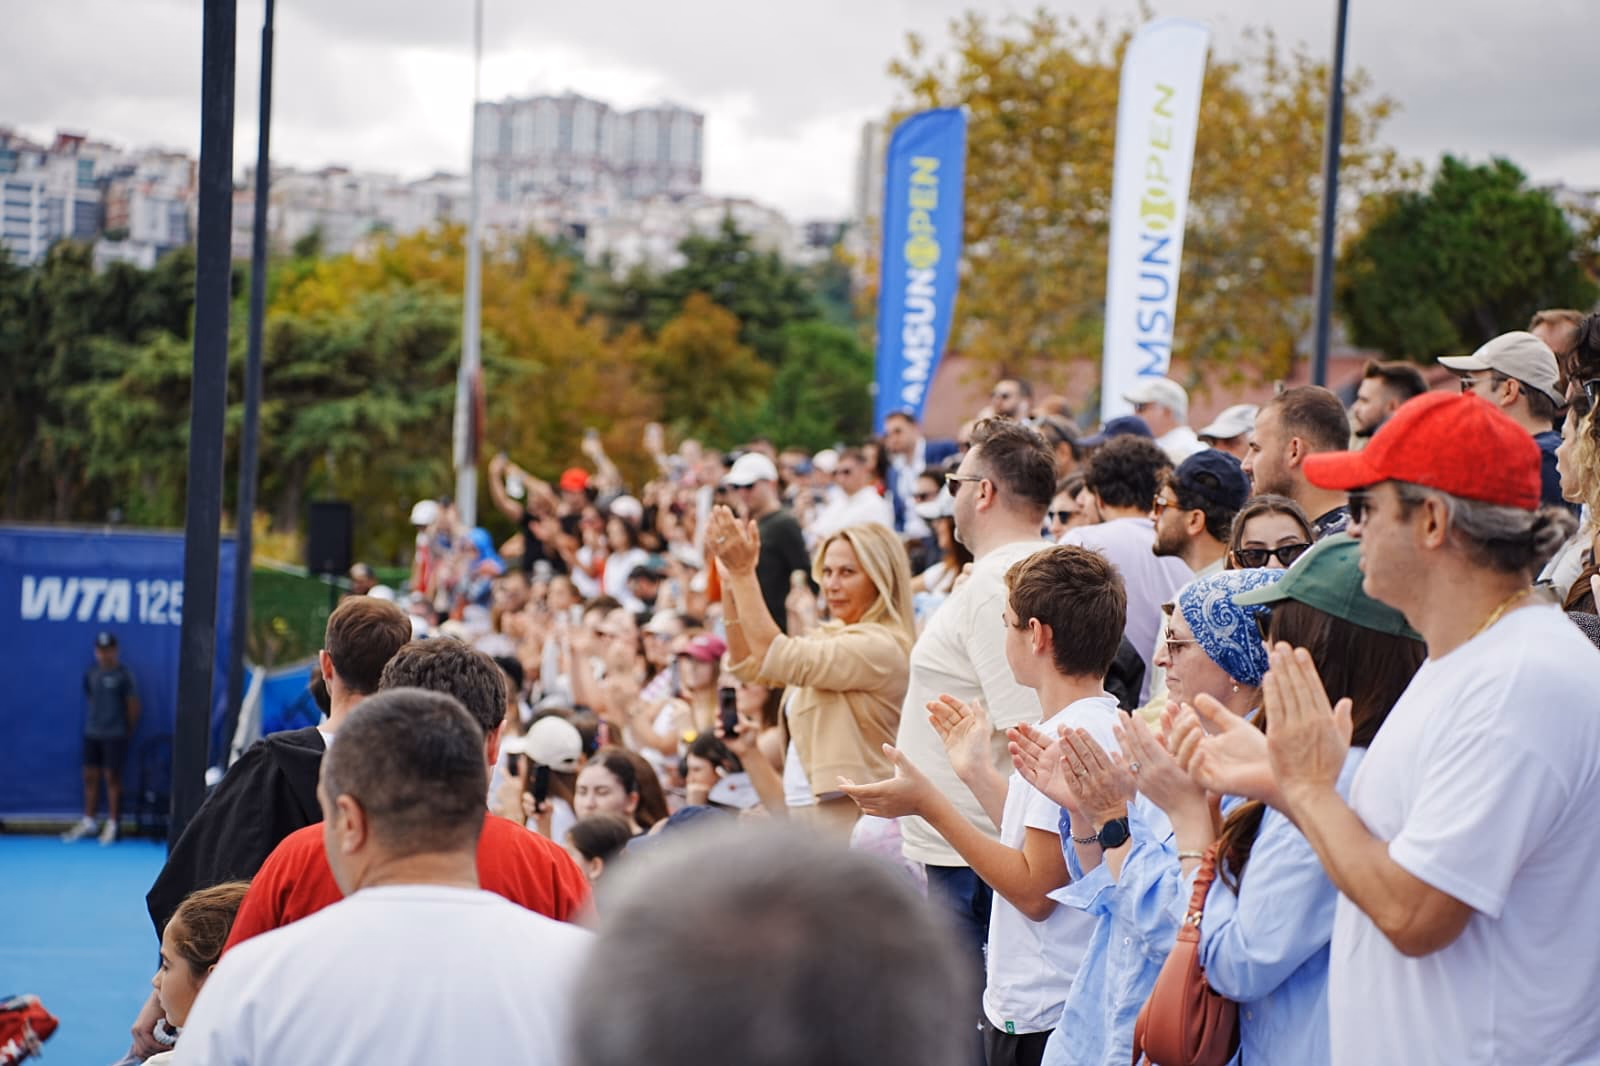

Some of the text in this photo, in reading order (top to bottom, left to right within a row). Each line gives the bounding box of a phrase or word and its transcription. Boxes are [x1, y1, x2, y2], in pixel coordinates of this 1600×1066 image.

[901, 155, 941, 413] AMSUN OPEN
[1136, 232, 1172, 377] MSUN
[20, 575, 184, 626] WTA 125
